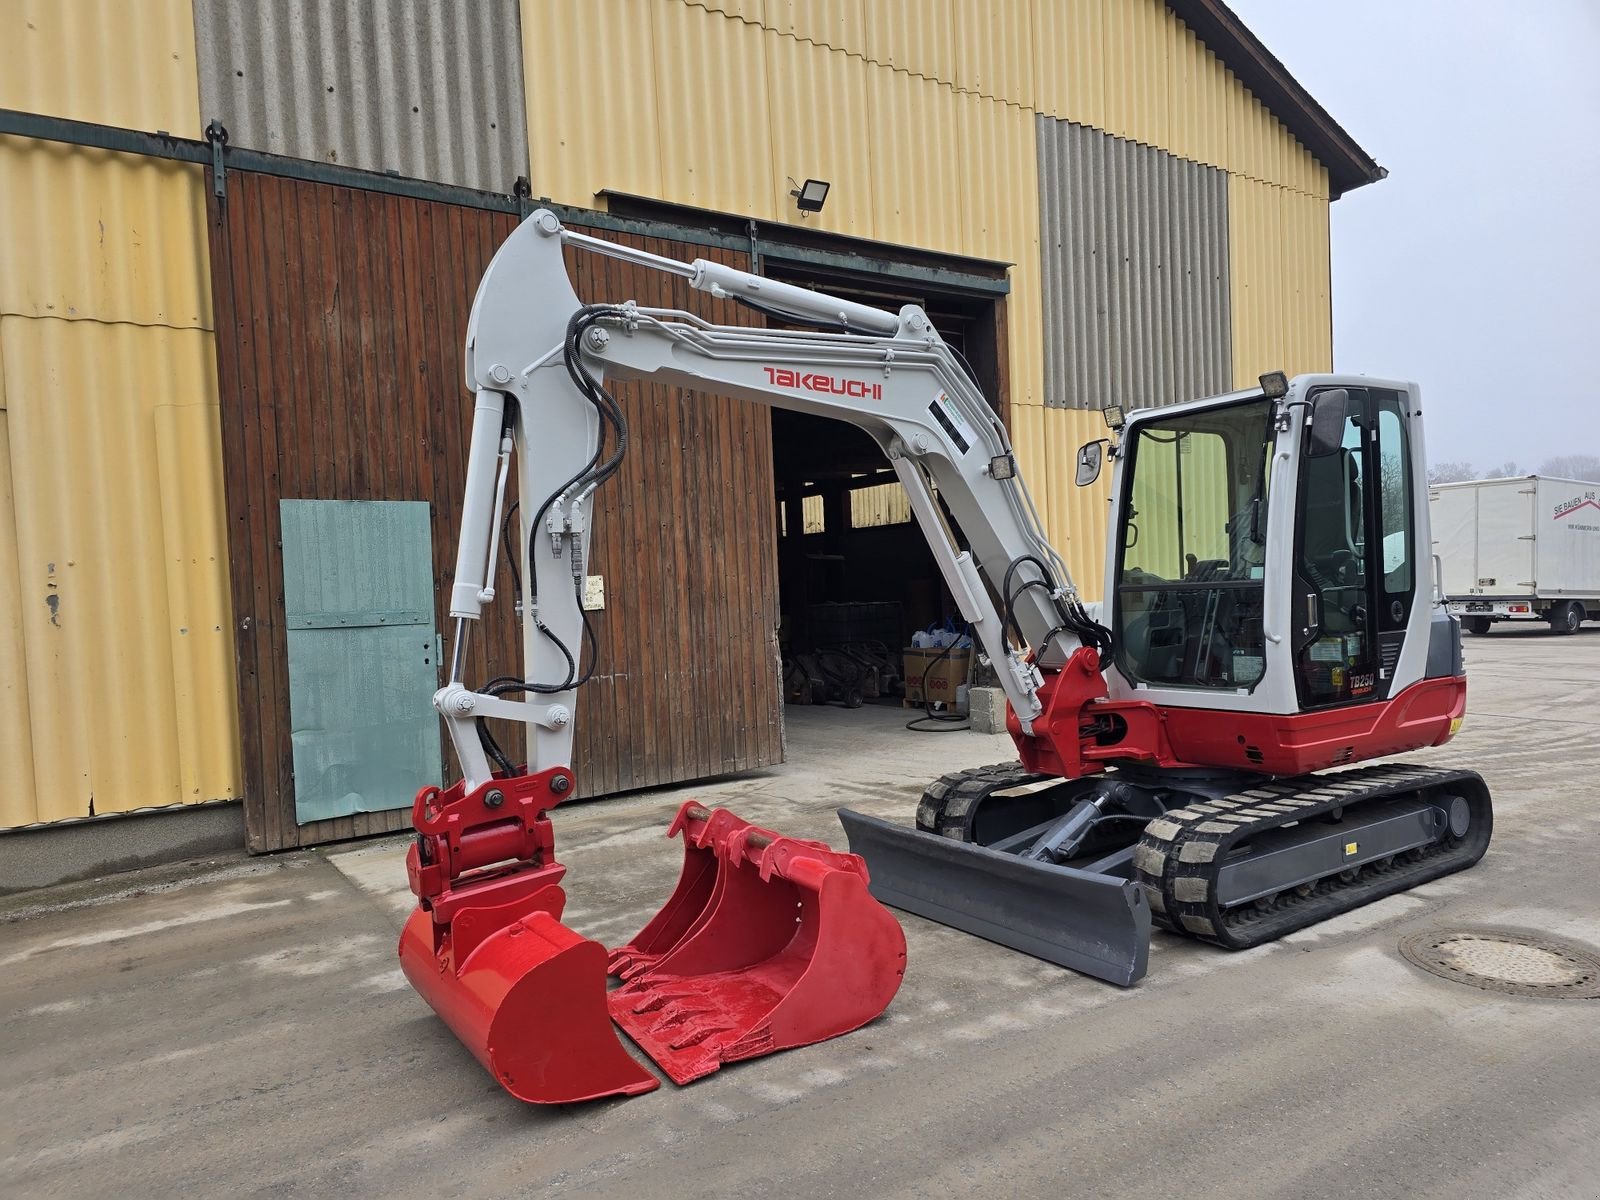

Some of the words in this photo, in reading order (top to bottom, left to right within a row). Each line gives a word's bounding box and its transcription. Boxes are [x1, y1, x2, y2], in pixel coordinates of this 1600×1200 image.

[763, 367, 882, 401] TAKEUCHI
[1554, 504, 1563, 514] SIE
[1564, 497, 1582, 510] BAUEN
[1585, 492, 1595, 500] AUS
[1350, 673, 1374, 688] TB250
